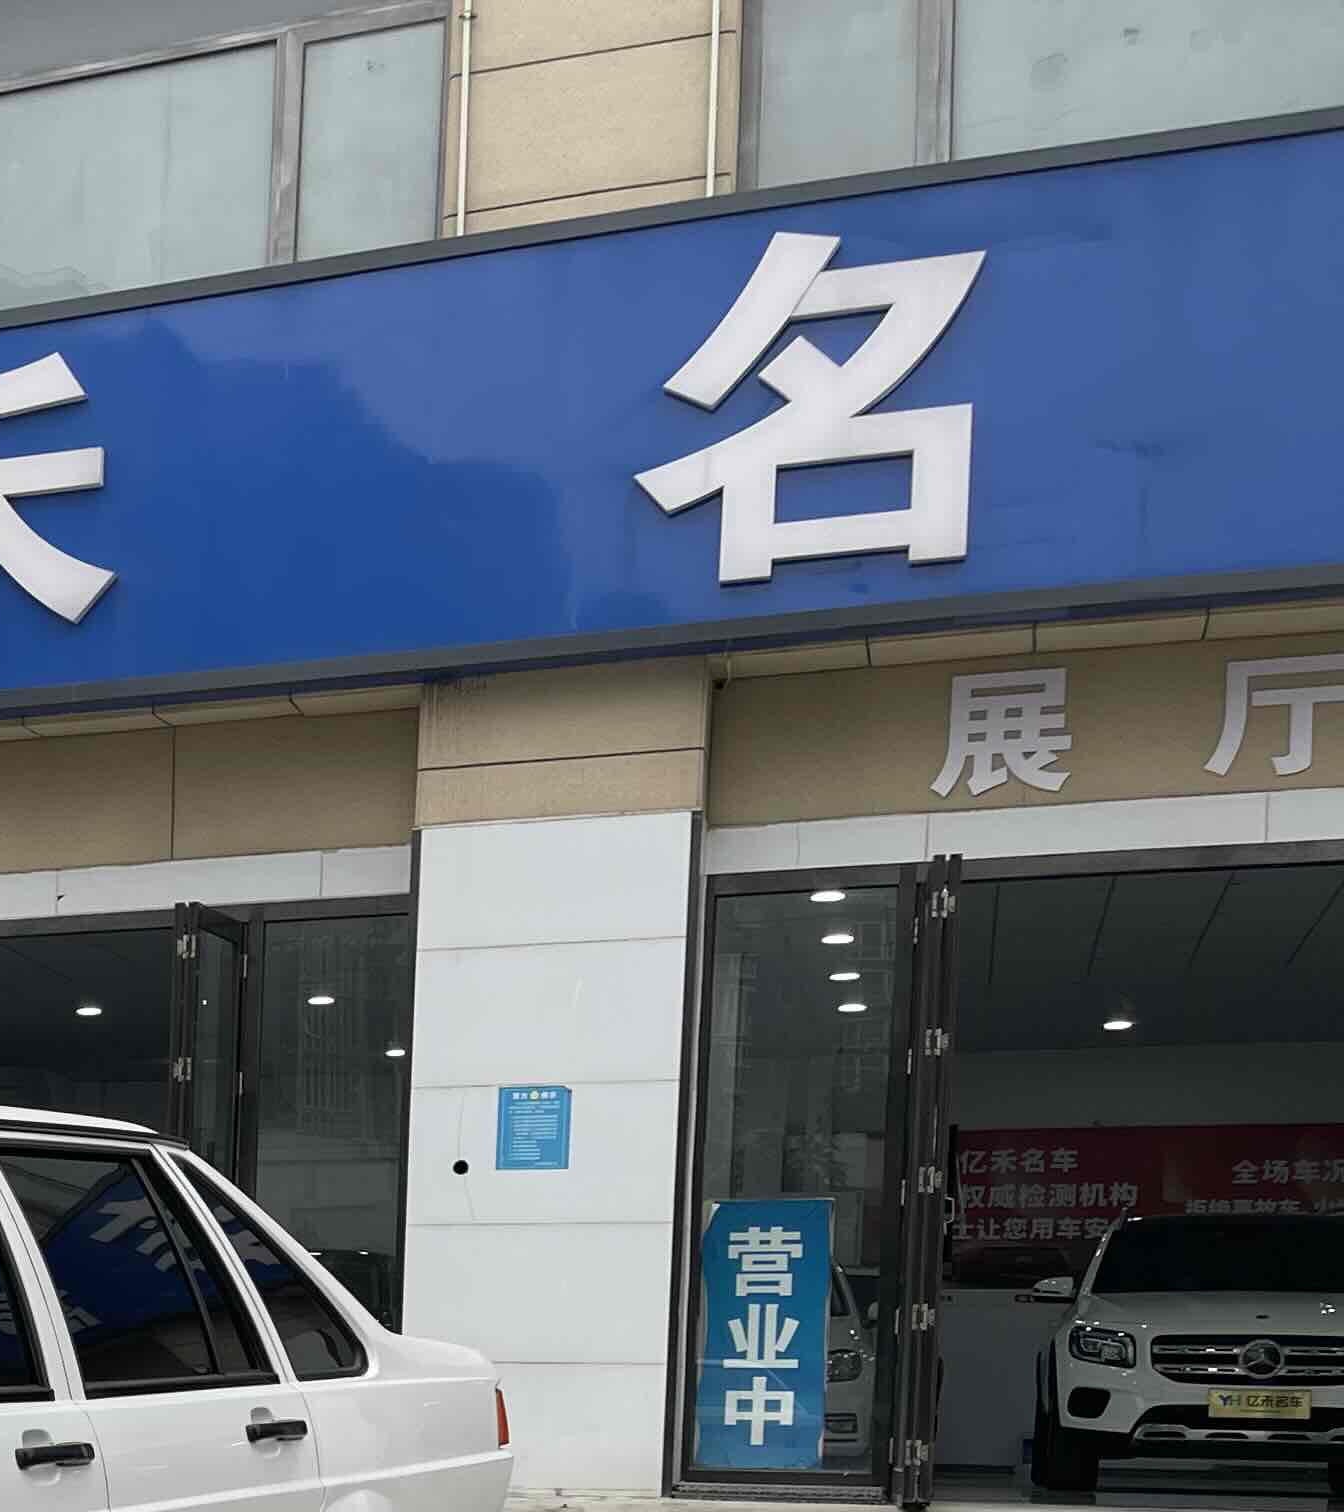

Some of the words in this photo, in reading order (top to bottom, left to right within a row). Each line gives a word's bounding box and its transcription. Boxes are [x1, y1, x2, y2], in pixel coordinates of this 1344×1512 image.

[929, 652, 1344, 797] 展厅
[962, 1149, 1079, 1174] 亿禾名车
[723, 1226, 804, 1446] 营业中
